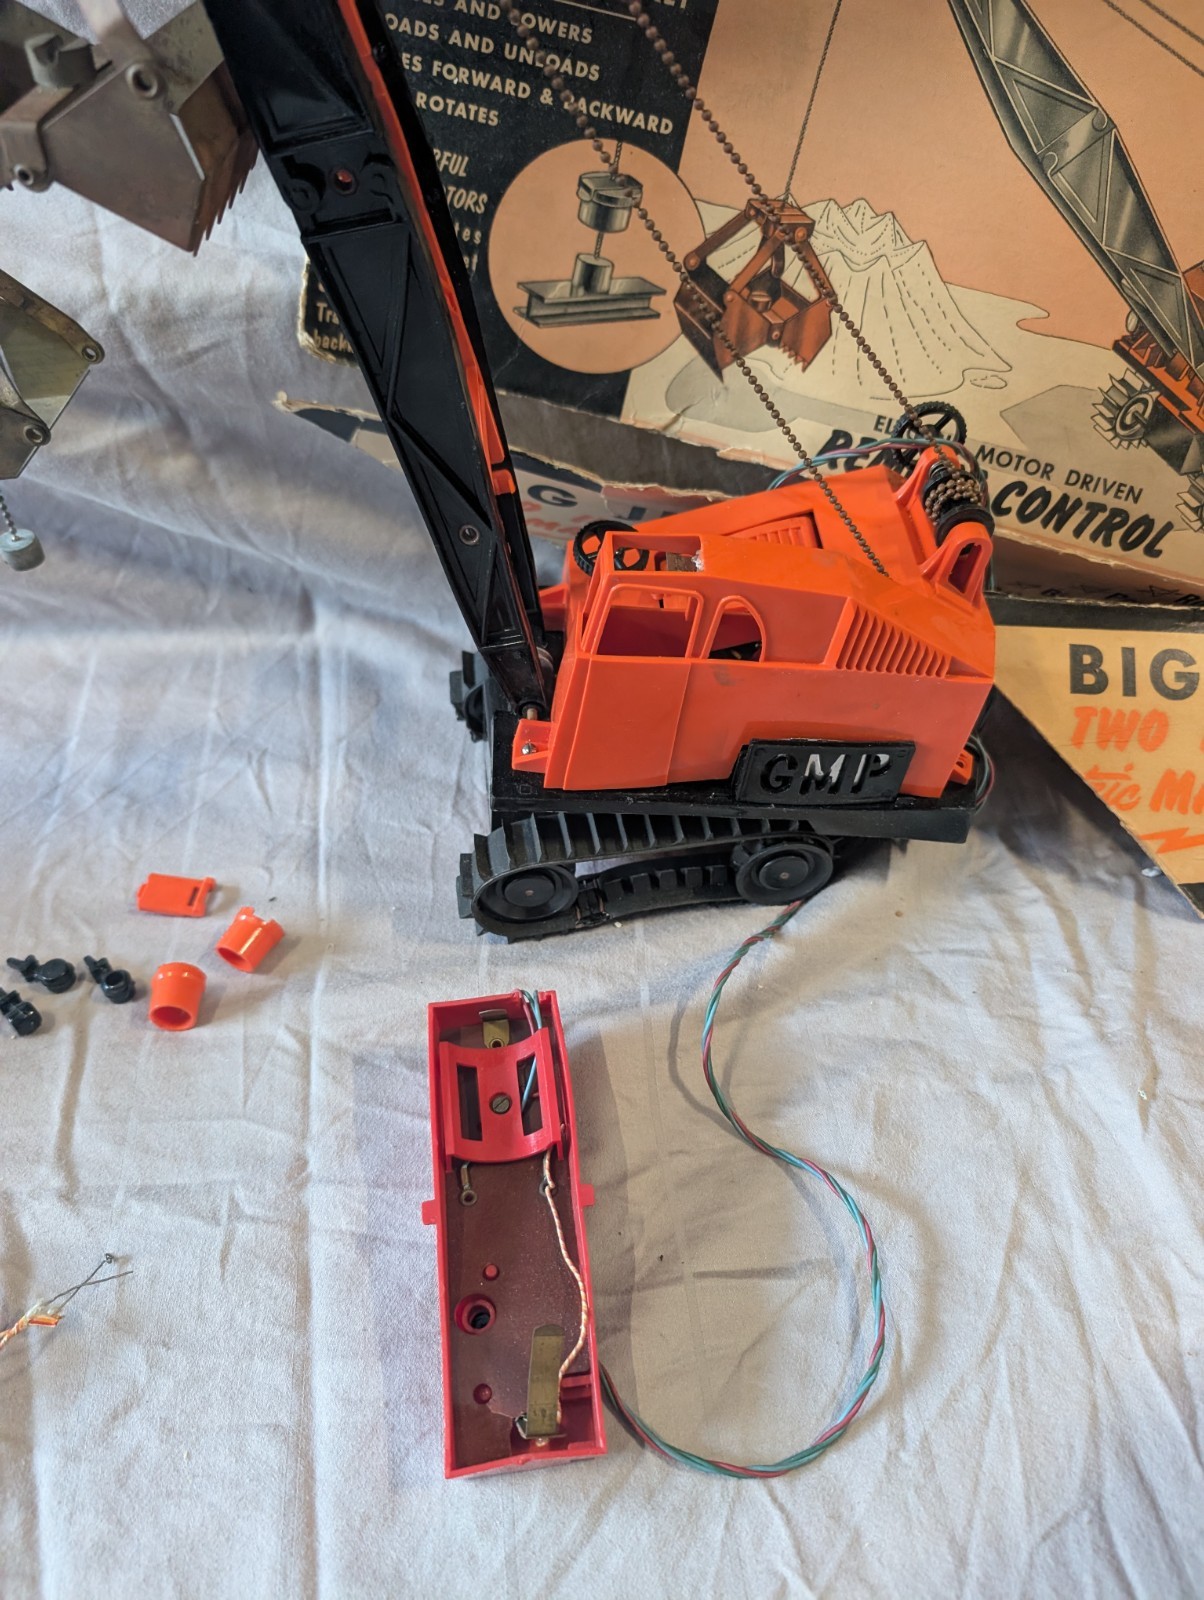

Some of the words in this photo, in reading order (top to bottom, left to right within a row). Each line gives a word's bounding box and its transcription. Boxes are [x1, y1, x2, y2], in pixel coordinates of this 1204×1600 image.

[384, 13, 440, 41] OADS
[448, 29, 495, 54] AND
[453, 0, 501, 20] AND
[510, 10, 593, 44] OWERS
[432, 60, 531, 99] FORWARD
[540, 88, 553, 106] &
[415, 91, 499, 126] ROTATES
[443, 185, 488, 214] TORS
[974, 445, 1055, 481] MOTOR
[1064, 470, 1143, 504] DRIVEN
[990, 480, 1175, 559] CONTROL
[1069, 643, 1200, 701] BIG
[1071, 705, 1170, 753] TWO
[760, 753, 892, 795] GMP
